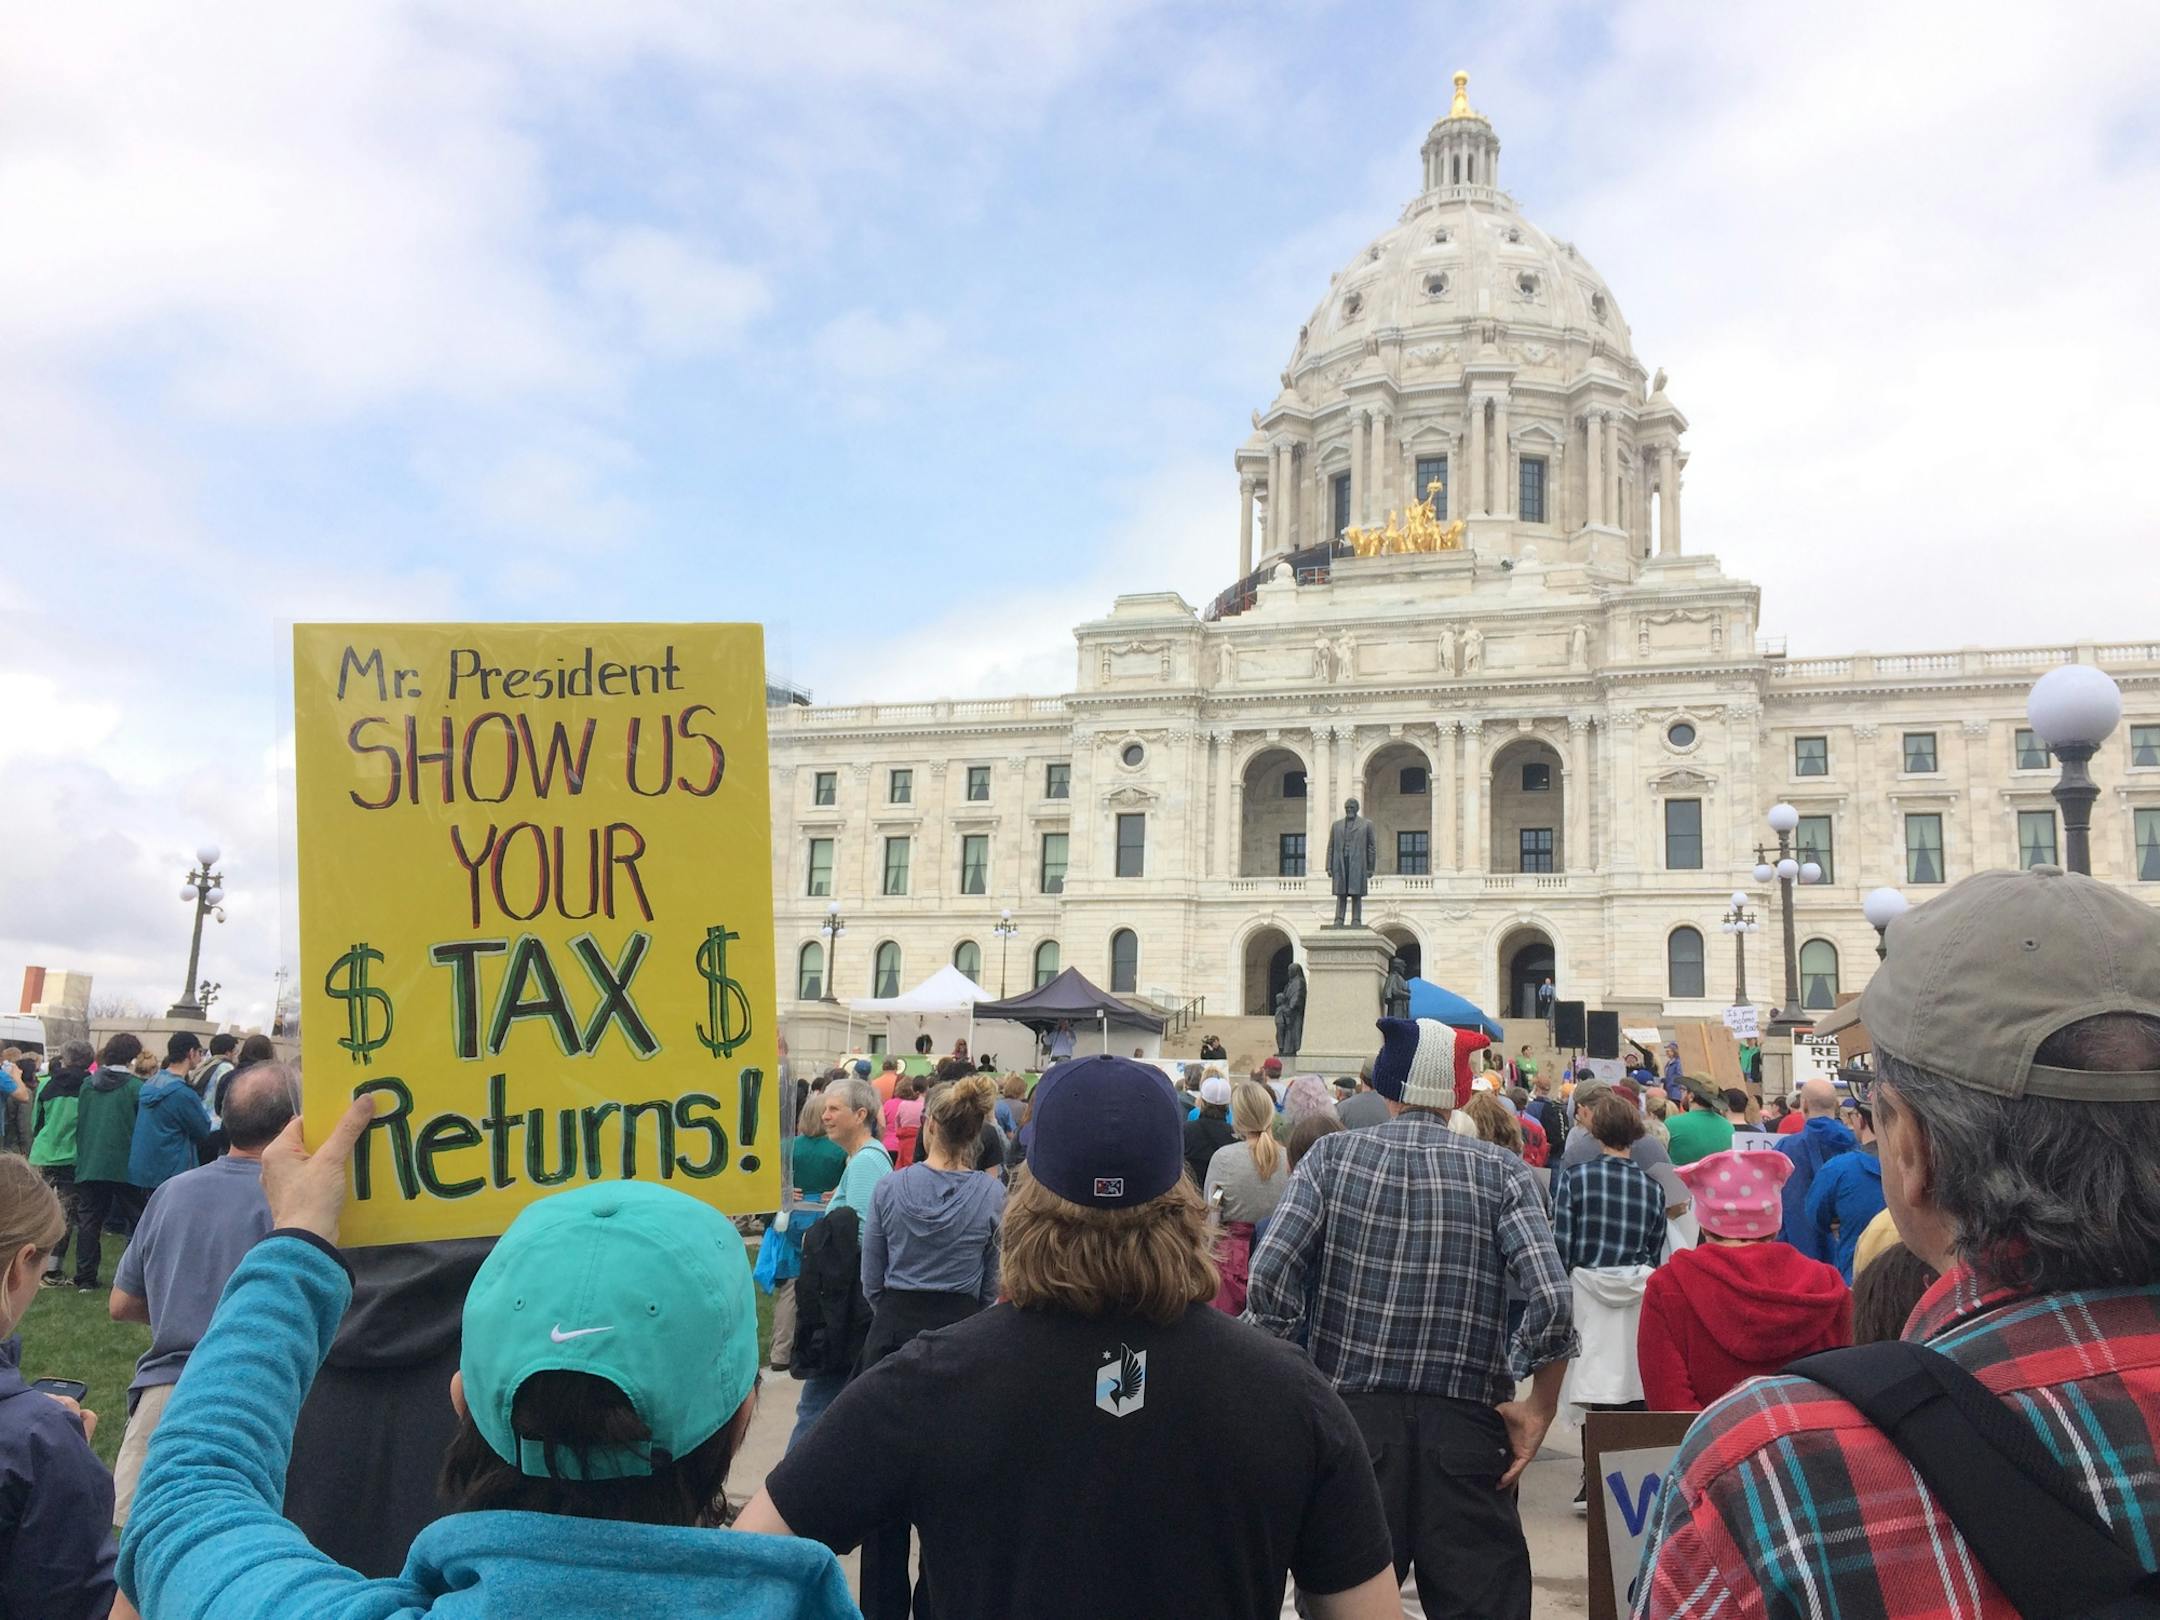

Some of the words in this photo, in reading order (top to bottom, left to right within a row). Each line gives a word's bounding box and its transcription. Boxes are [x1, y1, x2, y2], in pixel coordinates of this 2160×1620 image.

[338, 645, 422, 701] Mr.
[449, 645, 685, 700] President
[348, 711, 597, 810] SHOW
[626, 704, 726, 797] US
[450, 821, 654, 929] YOUR
[325, 942, 394, 1065] $
[427, 931, 662, 1061] TAX
[695, 925, 753, 1059] $
[352, 1066, 764, 1200] Returns!
